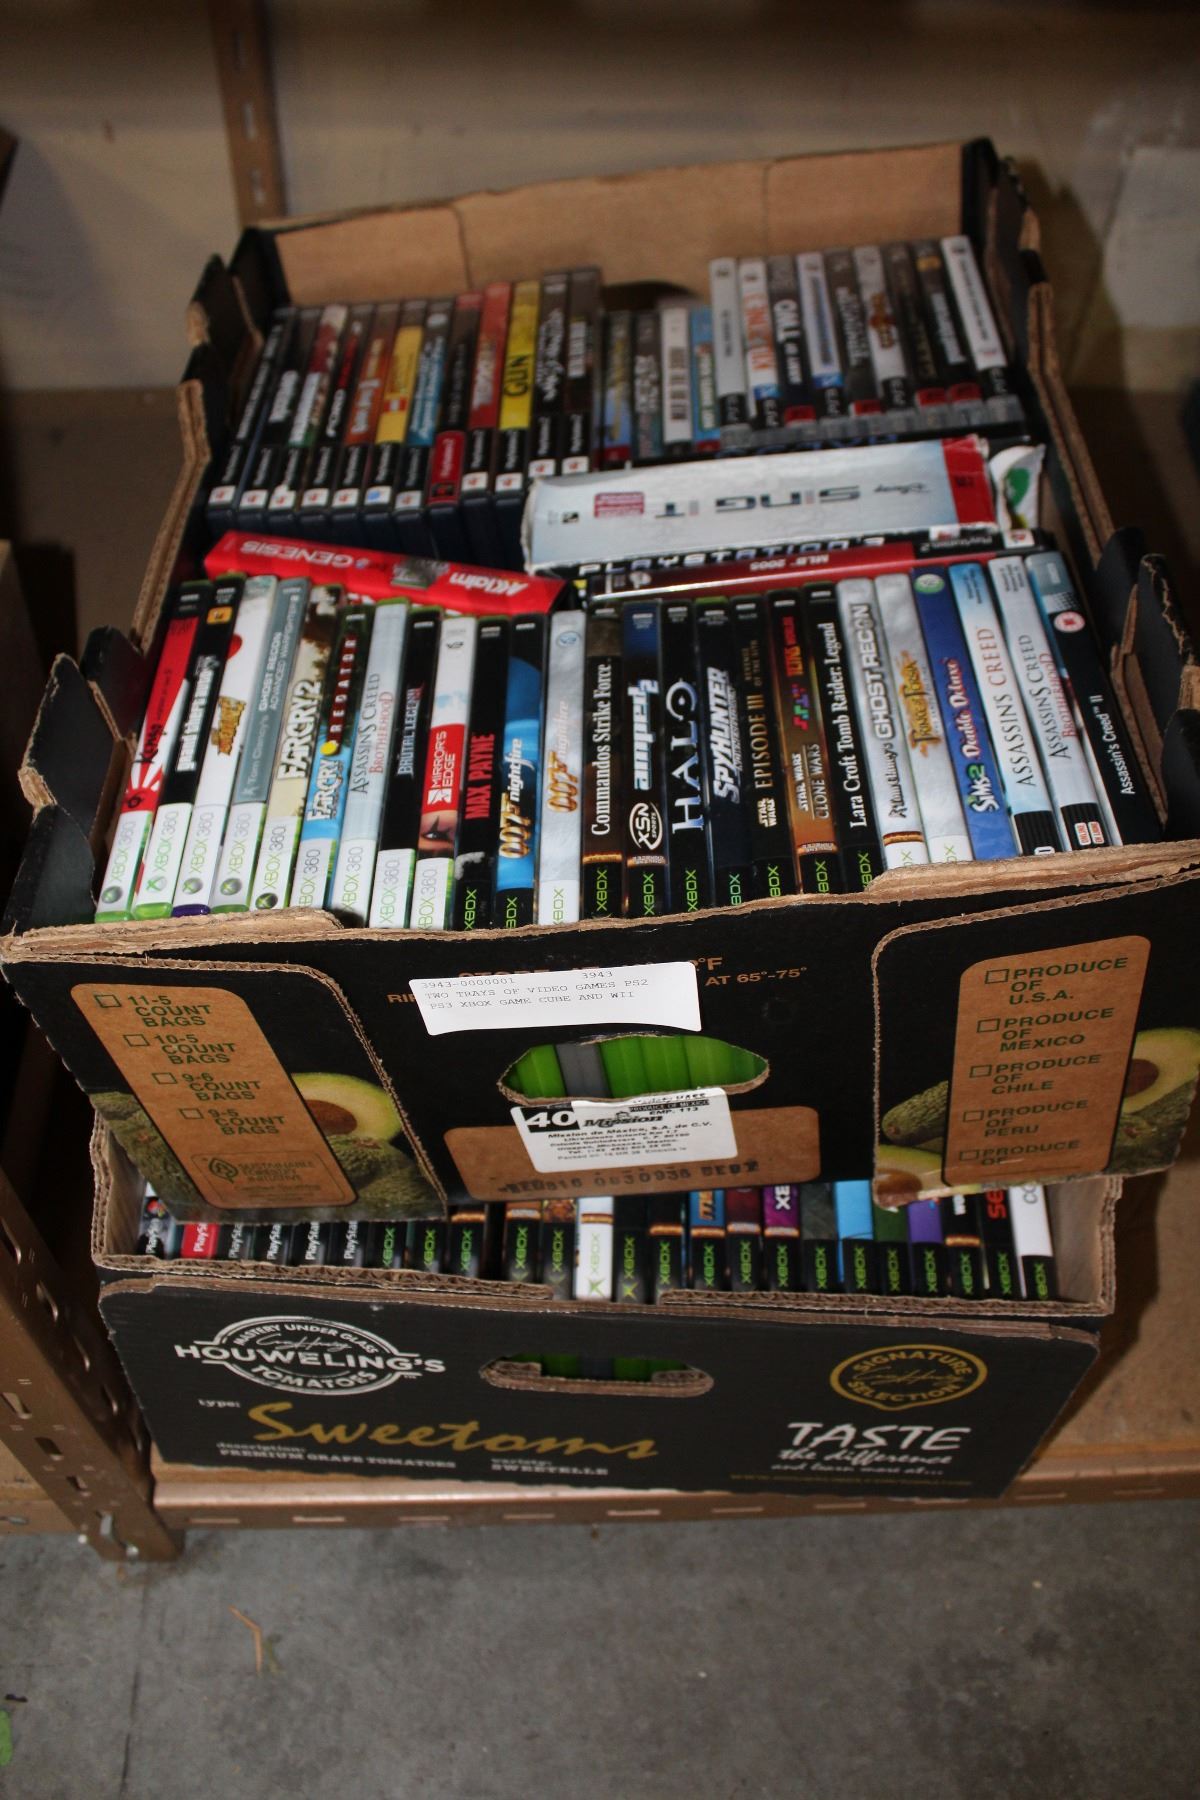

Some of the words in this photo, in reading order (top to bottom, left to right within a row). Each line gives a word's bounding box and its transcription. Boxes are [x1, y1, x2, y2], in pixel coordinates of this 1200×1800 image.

[767, 297, 805, 344] TWO
[502, 354, 530, 397] GUN
[874, 482, 931, 494] Disney
[241, 539, 353, 568] GENESIS
[266, 631, 282, 670] RECON
[817, 621, 843, 658] Legend
[851, 602, 882, 667] RECON
[976, 628, 1006, 688] CREED
[1018, 634, 1045, 684] CREED
[258, 671, 274, 711] GHOST
[269, 660, 286, 710] ADVANCED
[362, 673, 380, 724] CREED
[591, 664, 612, 714] Force
[825, 660, 849, 707] Raider:
[939, 658, 969, 710] Deluxe
[1038, 653, 1078, 737] BROTHERHOOD
[746, 691, 765, 709] III
[866, 675, 896, 741] GHOST
[252, 715, 270, 759] Clancy's
[591, 717, 612, 758] Strike
[629, 686, 654, 791] amped
[707, 667, 739, 804] SPYHUNTER
[832, 709, 853, 749] Tomb
[952, 709, 983, 760] Double
[469, 733, 495, 782] PAYNE
[666, 679, 704, 834] HALO
[750, 713, 773, 789] EPISODE
[792, 753, 804, 781] WARS
[806, 744, 824, 775] WARS
[246, 760, 260, 785] Tom
[443, 752, 456, 793] EDGE
[508, 738, 535, 802] nightfire
[548, 752, 579, 813] 007
[841, 751, 857, 794] Croft
[1109, 740, 1136, 795] Assassin's
[465, 784, 490, 820] MAX
[591, 760, 612, 836] Commandos
[766, 798, 778, 828] WARS
[796, 783, 808, 812] STAR
[812, 779, 829, 819] CLONE
[849, 796, 868, 829] Lara
[161, 810, 180, 836] 360
[198, 811, 214, 837] 360
[234, 812, 250, 838] 360
[499, 792, 532, 858] 007
[637, 802, 652, 847] XSN
[651, 811, 659, 839] SPORTS
[758, 801, 767, 828] STAR
[118, 820, 136, 847] 360
[269, 825, 286, 851] 360
[111, 848, 129, 882] XBOX
[154, 836, 172, 872] XBOX
[189, 839, 209, 874] XBOX
[227, 840, 246, 874] XBOX
[303, 849, 321, 874] 360
[352, 846, 364, 873] 360
[262, 853, 280, 890] XBOX
[383, 859, 400, 885] 360
[422, 869, 437, 895] 360
[379, 887, 397, 924] XBOX
[596, 869, 608, 912] XBOX
[642, 873, 655, 916] XBOX
[685, 869, 697, 912] XBOX
[421, 978, 515, 989] 3943-0000001
[582, 971, 613, 979] 3943
[705, 975, 731, 987] AT
[1012, 957, 1129, 980] PRODUCE
[127, 995, 172, 1006] 11-5
[425, 992, 449, 1000] TWO
[456, 989, 495, 998] TRAYS
[528, 985, 568, 993] VIDEO
[576, 982, 616, 990] GAMES
[624, 978, 648, 987] PS2
[1009, 989, 1074, 1005] U.S.A.
[1010, 979, 1042, 992] OF
[134, 1004, 212, 1016] COUNT
[431, 1002, 452, 1010] PS3
[461, 1000, 492, 1008] XBOX
[500, 998, 532, 1006] GAME
[539, 995, 571, 1003] CUBE
[1003, 1007, 1115, 1029] PRODUCE
[141, 1016, 207, 1028] BAGS
[1002, 1028, 1033, 1041] OF
[153, 1033, 199, 1044] 10-5
[160, 1042, 236, 1054] COUNT
[1000, 1033, 1086, 1052] MEXICO
[168, 1054, 231, 1065] BAGS
[995, 1054, 1102, 1074] PRODUCE
[180, 1072, 214, 1082] 9-6
[188, 1080, 261, 1091] COUNT
[991, 1080, 1054, 1095] CHILE
[994, 1073, 1023, 1084] OF
[194, 1090, 256, 1101] BAGS
[988, 1099, 1089, 1118] PRODUCE
[207, 1109, 238, 1118] 9-5
[214, 1116, 285, 1126] COUNT
[525, 1111, 578, 1128] 40
[986, 1116, 1013, 1128] OF
[221, 1125, 281, 1135] BAGS
[548, 1131, 587, 1139] Mission
[984, 1124, 1039, 1137] PERU
[980, 1140, 1080, 1158] PRODUCE
[460, 1230, 472, 1272] XBOX
[515, 1227, 528, 1269] XBOX
[553, 1231, 564, 1272] XBOX
[590, 1233, 601, 1274] XBOX
[624, 1237, 635, 1279] XBOX
[659, 1241, 671, 1285] XBOX
[741, 1241, 751, 1284] XBOX
[704, 1244, 714, 1287] XBOX
[777, 1245, 788, 1287] XBOX
[816, 1248, 826, 1289] XBOX
[854, 1248, 866, 1289] XBOX
[888, 1251, 900, 1292] XBOX
[925, 1251, 938, 1293] XBOX
[961, 1253, 973, 1295] XBOX
[999, 1253, 1012, 1295] XBOX
[233, 1324, 281, 1347] MASTERY
[284, 1323, 337, 1336] UNDER
[340, 1332, 379, 1354] GLASS
[174, 1344, 446, 1374] HOUWELING'S
[852, 1351, 973, 1376] SIGNATURE
[250, 1364, 377, 1389] TOMATOES
[848, 1381, 961, 1401] SELECTION
[198, 1398, 241, 1408] type:
[247, 1401, 659, 1461] Sweetoms
[786, 1421, 972, 1452] TASTE
[219, 1449, 305, 1460] PREMIUM
[771, 1462, 807, 1471] and
[779, 1448, 815, 1461] the
[833, 1445, 953, 1467] difference
